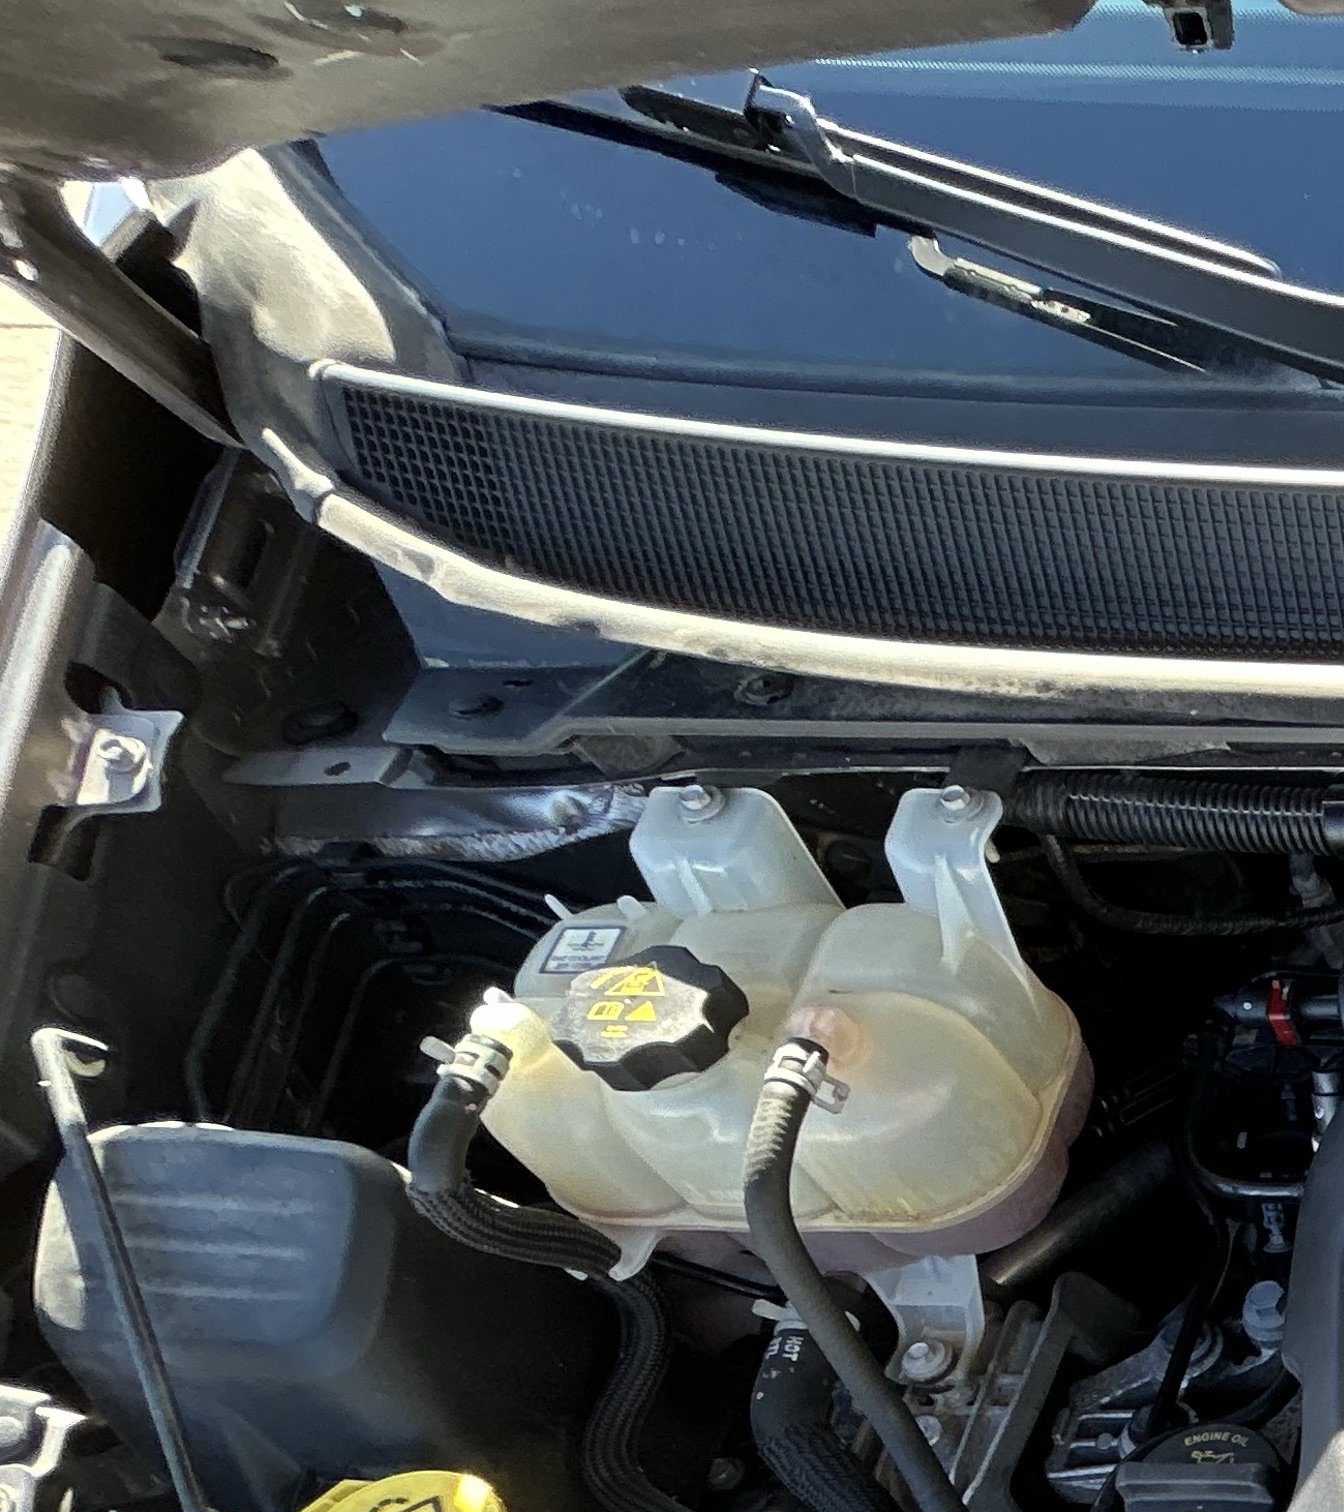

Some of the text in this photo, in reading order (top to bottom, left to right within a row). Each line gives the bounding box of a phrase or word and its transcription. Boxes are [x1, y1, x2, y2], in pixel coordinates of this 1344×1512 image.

[782, 1335, 804, 1362] HOT
[1184, 1431, 1250, 1448] ENGINE OIL
